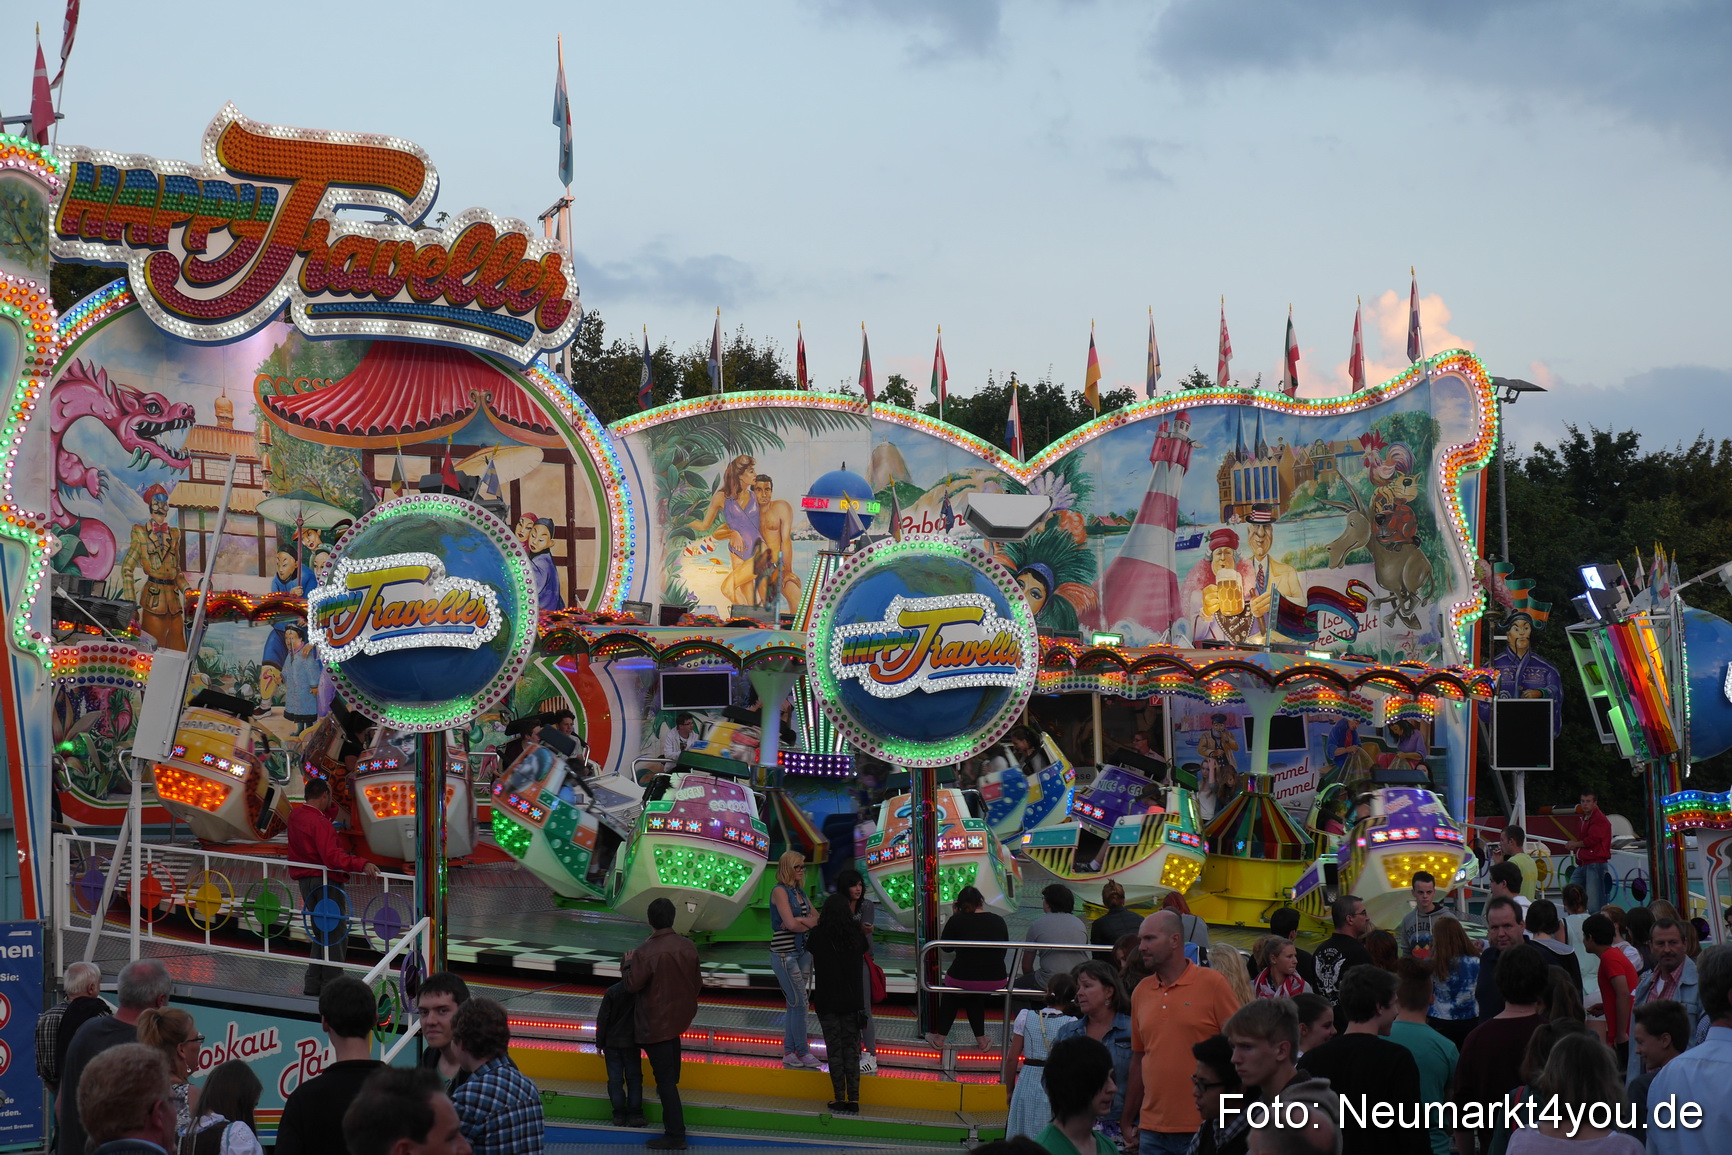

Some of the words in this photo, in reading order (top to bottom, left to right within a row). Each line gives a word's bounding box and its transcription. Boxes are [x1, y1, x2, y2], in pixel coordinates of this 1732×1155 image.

[54, 161, 280, 287] HAPPY
[143, 120, 573, 331] Traveller
[326, 565, 490, 648] Traveller
[841, 629, 920, 671] HAPPY
[868, 606, 1024, 685] Traveller
[1127, 784, 1145, 797] EA
[1273, 773, 1315, 800] ummel
[1274, 756, 1309, 783] mmel
[192, 1024, 278, 1072] oskau
[0, 1109, 22, 1117] rden.
